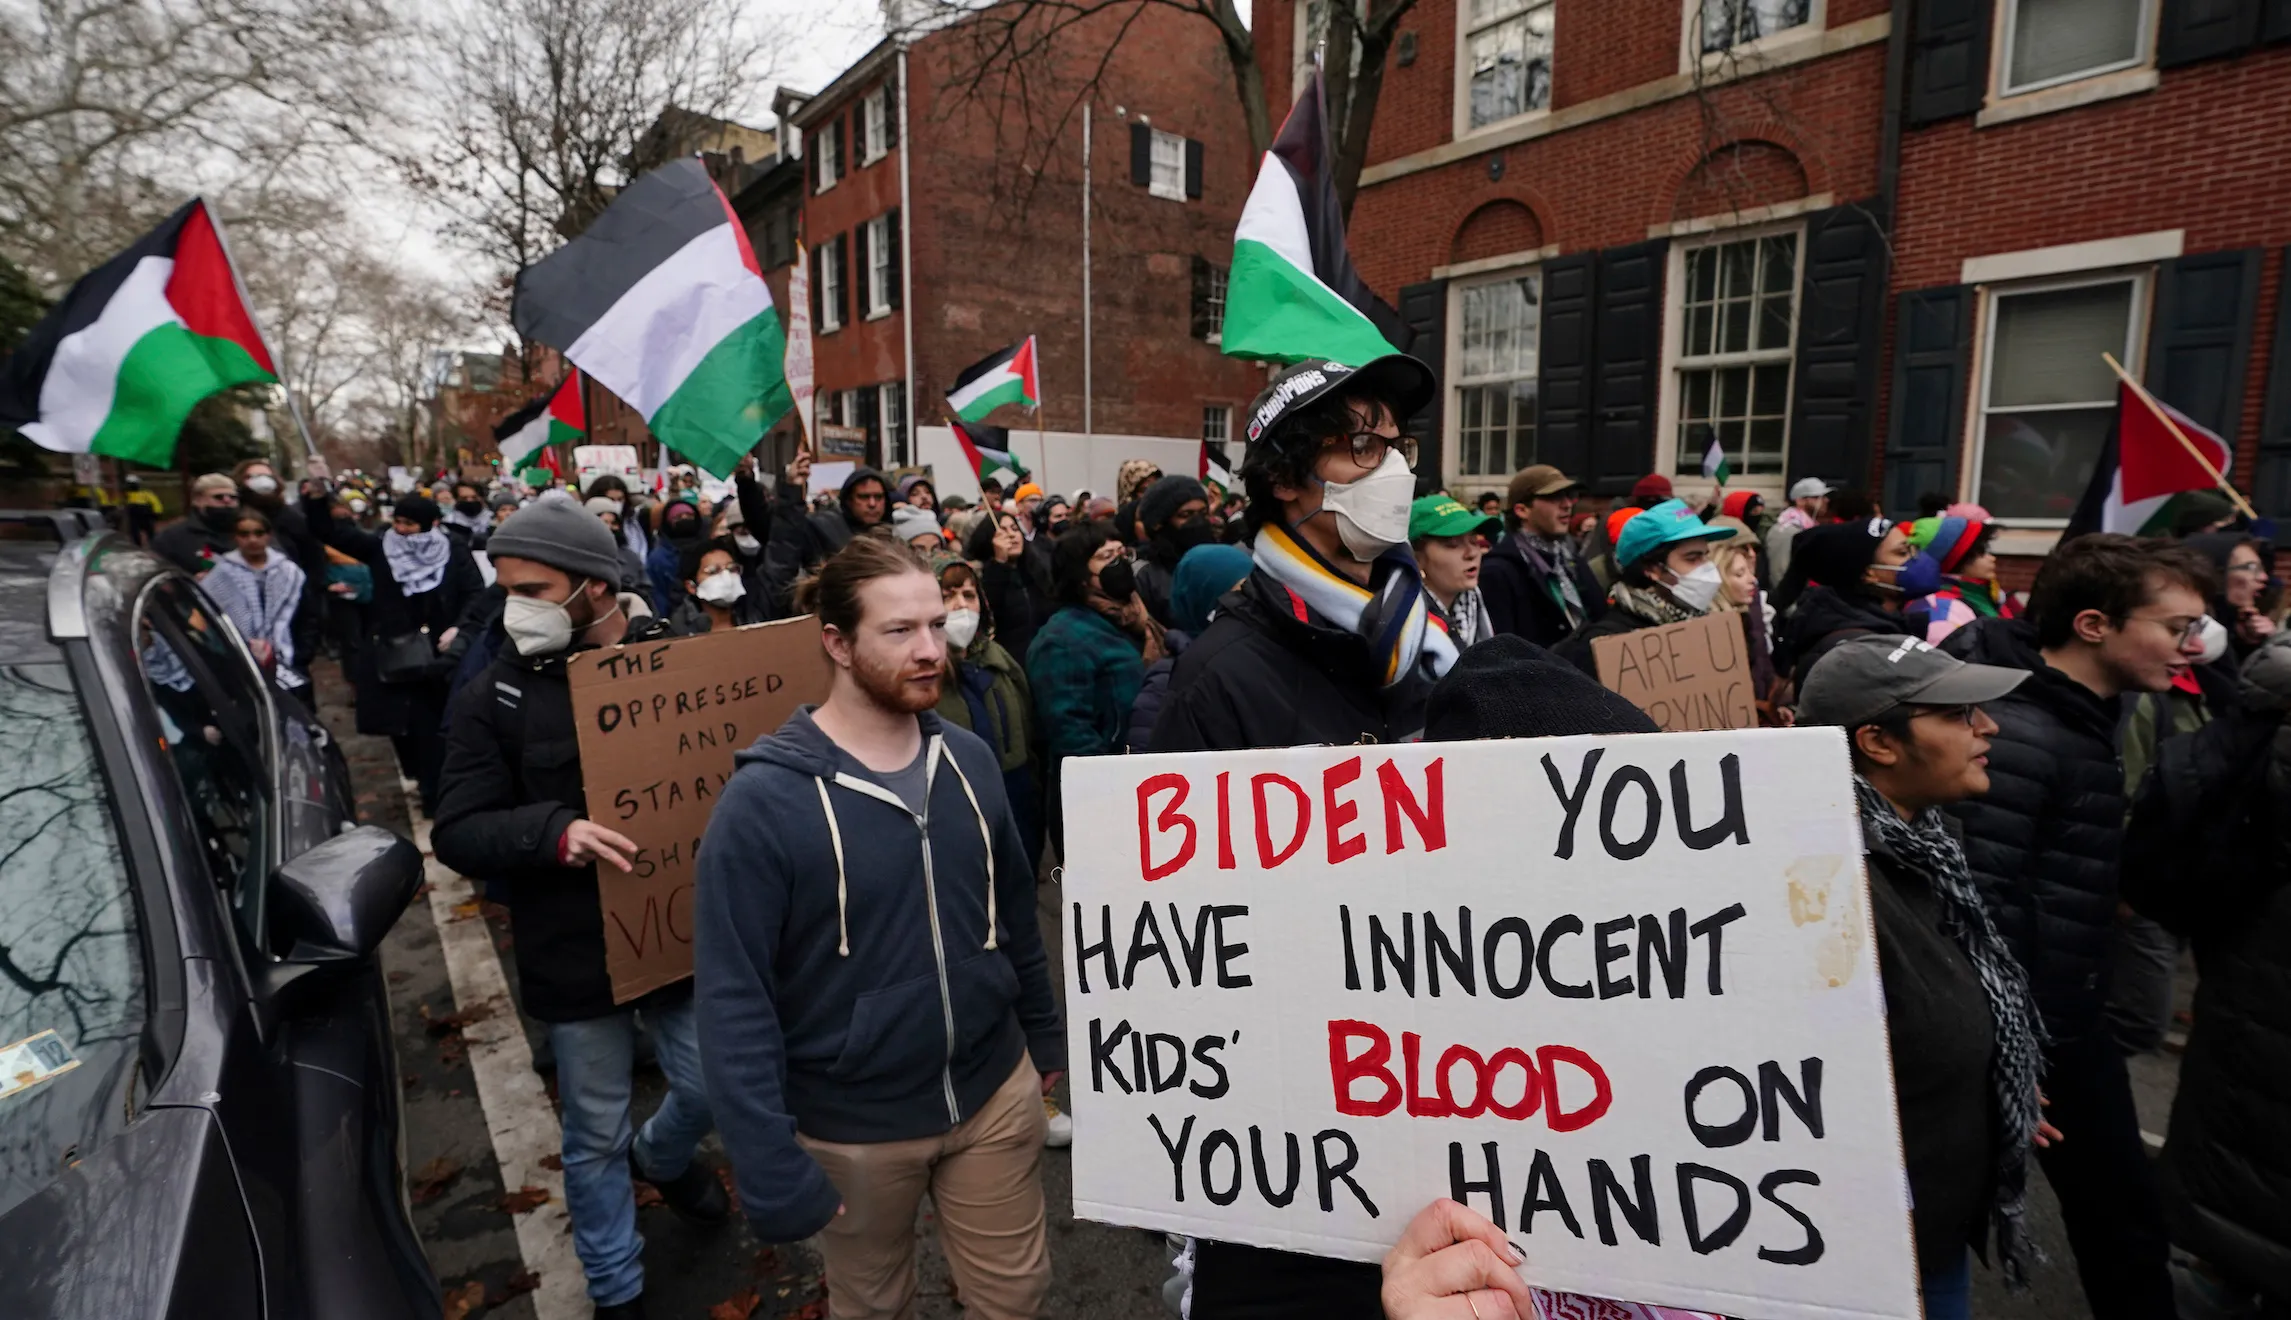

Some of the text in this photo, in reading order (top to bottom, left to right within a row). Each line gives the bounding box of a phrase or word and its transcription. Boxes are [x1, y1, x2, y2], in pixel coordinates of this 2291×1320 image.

[1257, 369, 1327, 427] CHAMPIONS
[598, 645, 671, 679] THE
[1617, 621, 1738, 694] ARE U
[598, 673, 784, 733] OPPRESSED
[1636, 681, 1750, 731] RYING
[678, 723, 738, 755] AND
[1136, 747, 1751, 882] BIDEN YOU
[1073, 900, 1746, 1001] HAVE INNOCENT
[1089, 1018, 1825, 1149] KIDS' BLOOD ON
[1146, 1113, 1826, 1266] YOUR HANDS
